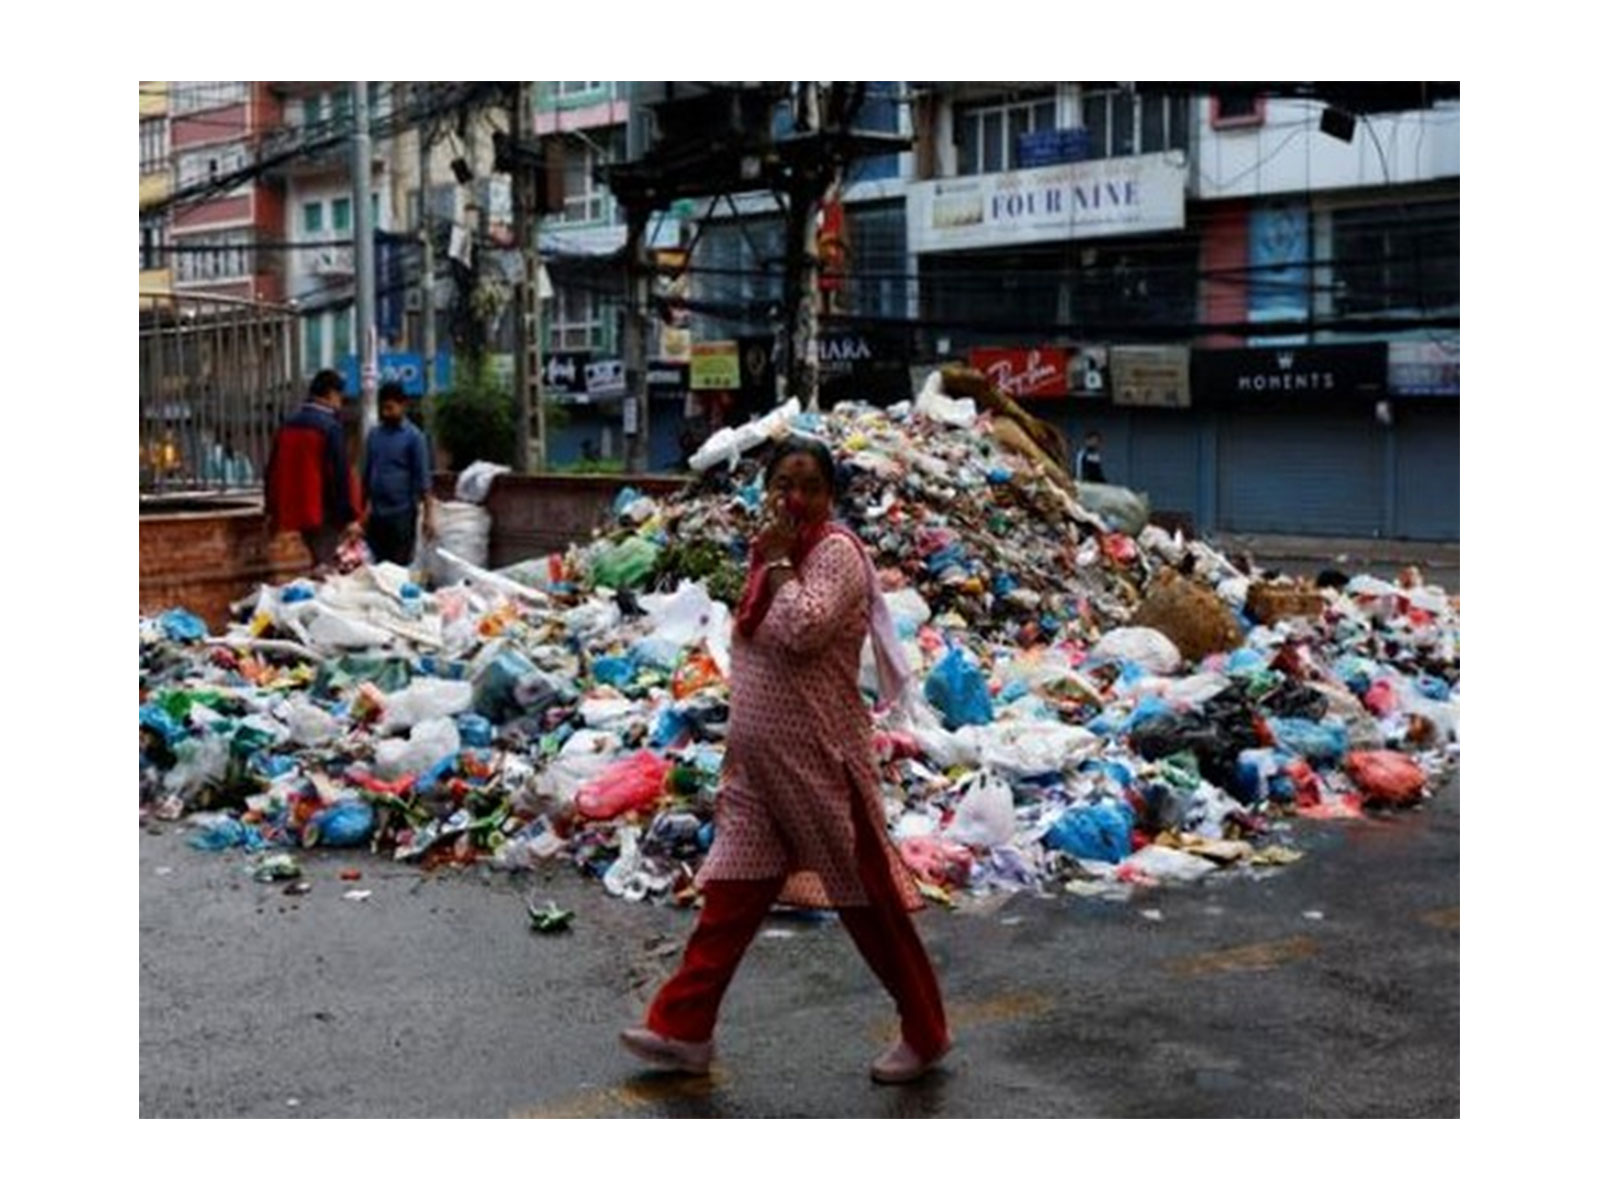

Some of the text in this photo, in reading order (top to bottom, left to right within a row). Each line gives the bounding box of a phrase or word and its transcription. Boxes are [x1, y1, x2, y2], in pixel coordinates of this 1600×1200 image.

[991, 189, 1062, 219] FOUR
[1076, 180, 1140, 209] NINE
[1238, 372, 1335, 391] MOMENTS
